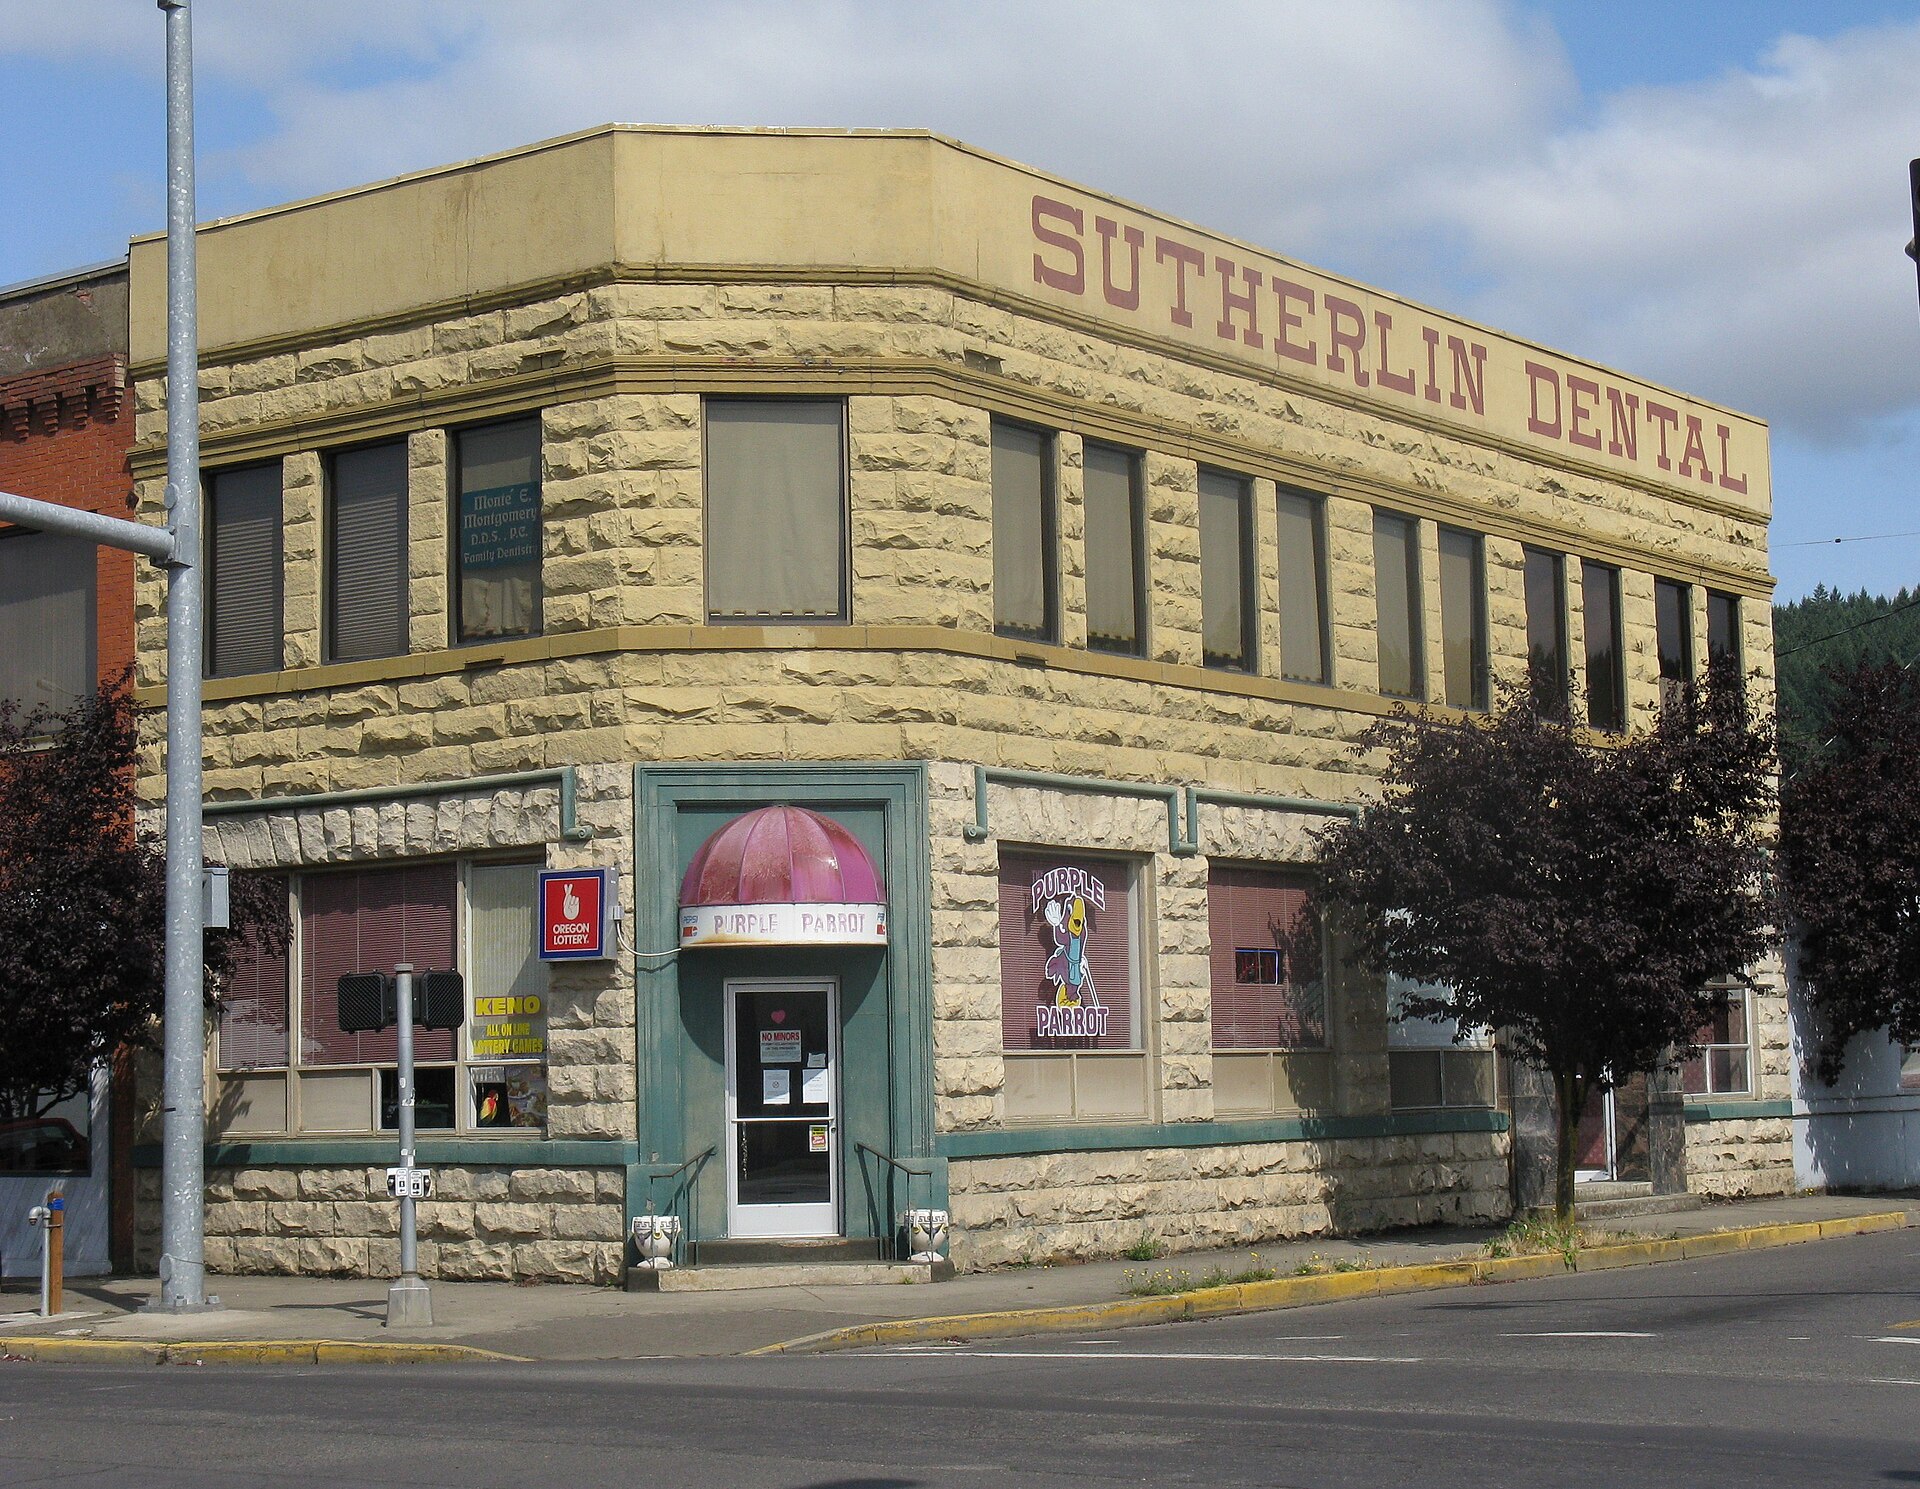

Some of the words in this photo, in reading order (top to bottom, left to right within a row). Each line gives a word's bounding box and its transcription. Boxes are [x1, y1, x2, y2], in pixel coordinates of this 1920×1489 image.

[1031, 194, 1487, 416] SUTHERLIN
[1525, 360, 1748, 495] DENTAL
[520, 488, 532, 503] E.
[464, 507, 537, 529] Montgomery
[463, 550, 495, 564] Family
[1031, 867, 1106, 914] PURPLE
[553, 923, 590, 934] OREGON
[713, 913, 779, 934] PURPLE
[801, 913, 866, 933] PARROT
[475, 995, 541, 1017] KENO
[486, 1023, 500, 1037] ALL
[501, 1023, 512, 1037] ON
[513, 1022, 530, 1036] LINE
[1037, 1005, 1109, 1037] PARROT
[473, 1039, 511, 1055] LOTTERY
[512, 1038, 543, 1054] GAMES
[762, 1032, 773, 1042] NO
[774, 1032, 800, 1041] MINORS
